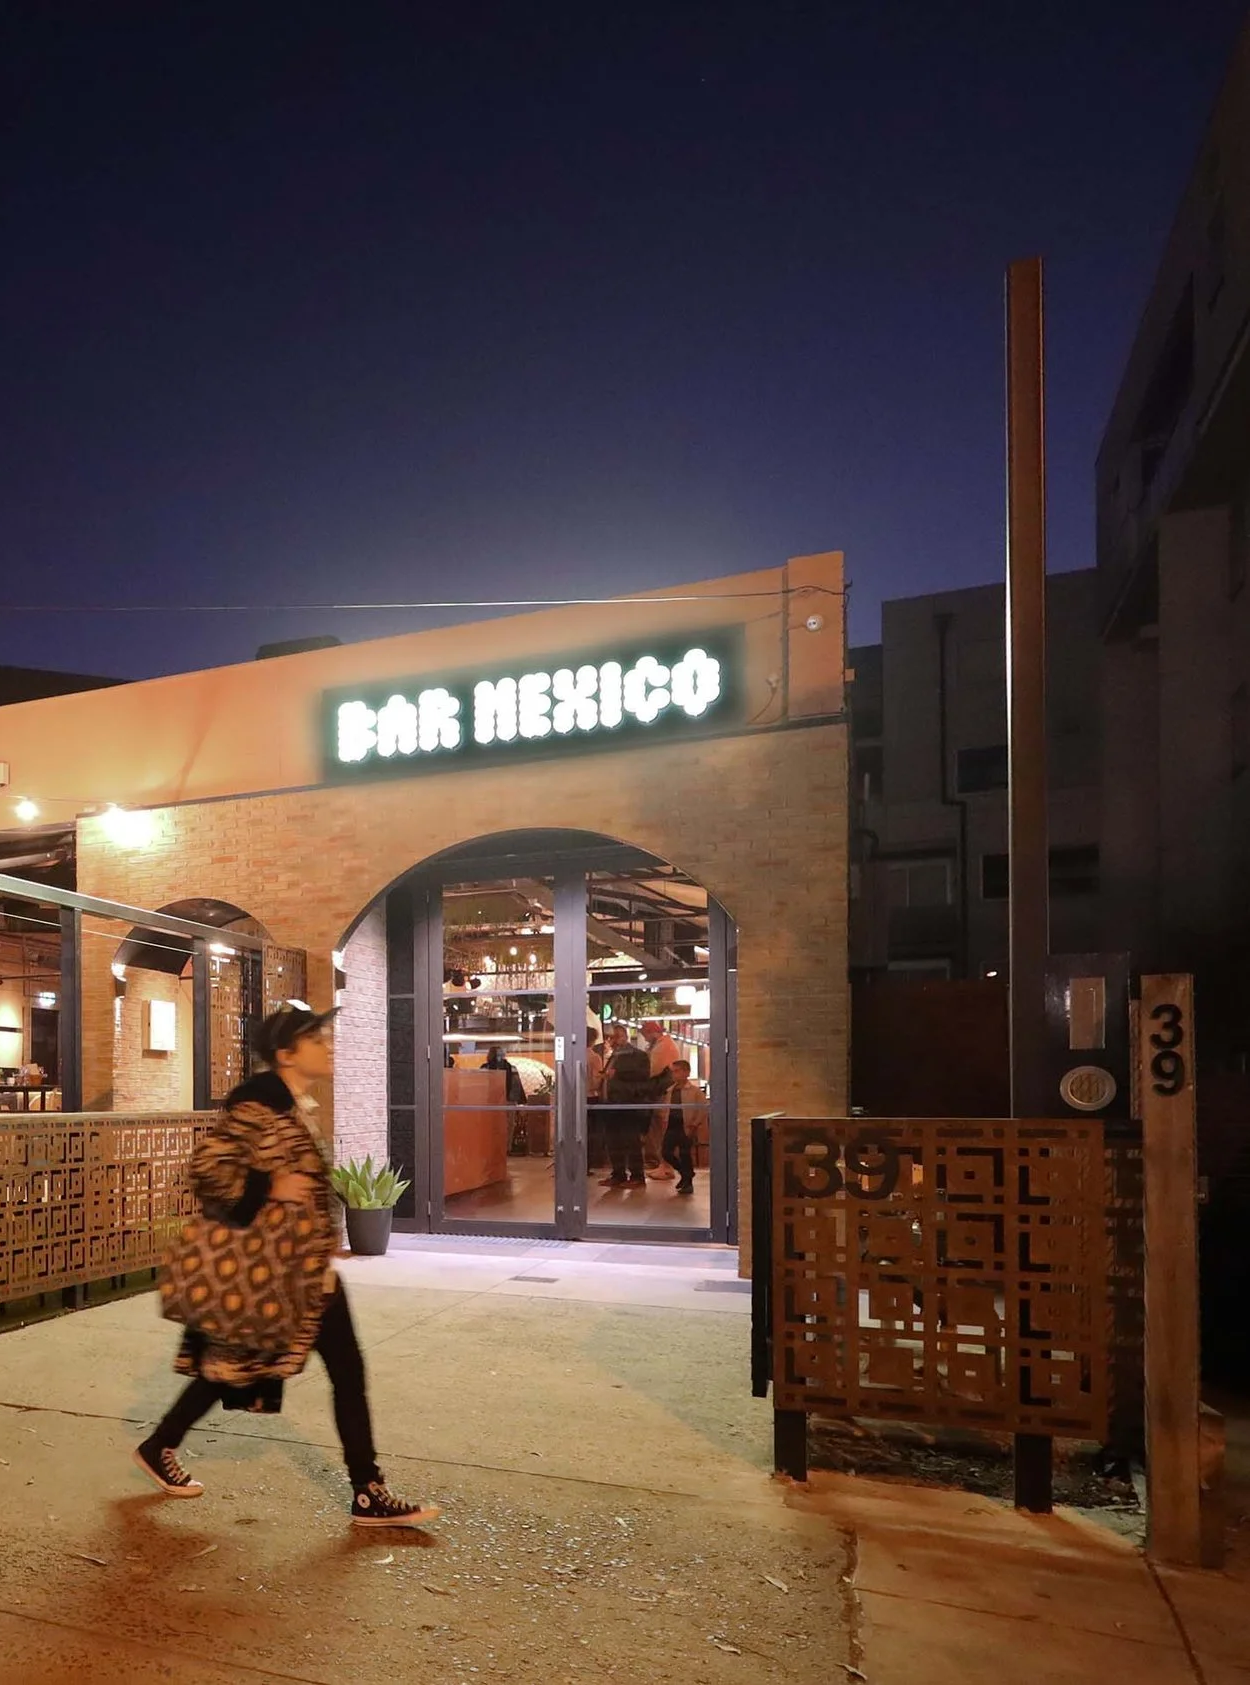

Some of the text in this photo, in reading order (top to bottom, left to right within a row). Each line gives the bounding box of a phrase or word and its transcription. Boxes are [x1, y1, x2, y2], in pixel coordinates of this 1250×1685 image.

[337, 648, 720, 763] BAR MEXICO
[786, 1128, 900, 1200] 39
